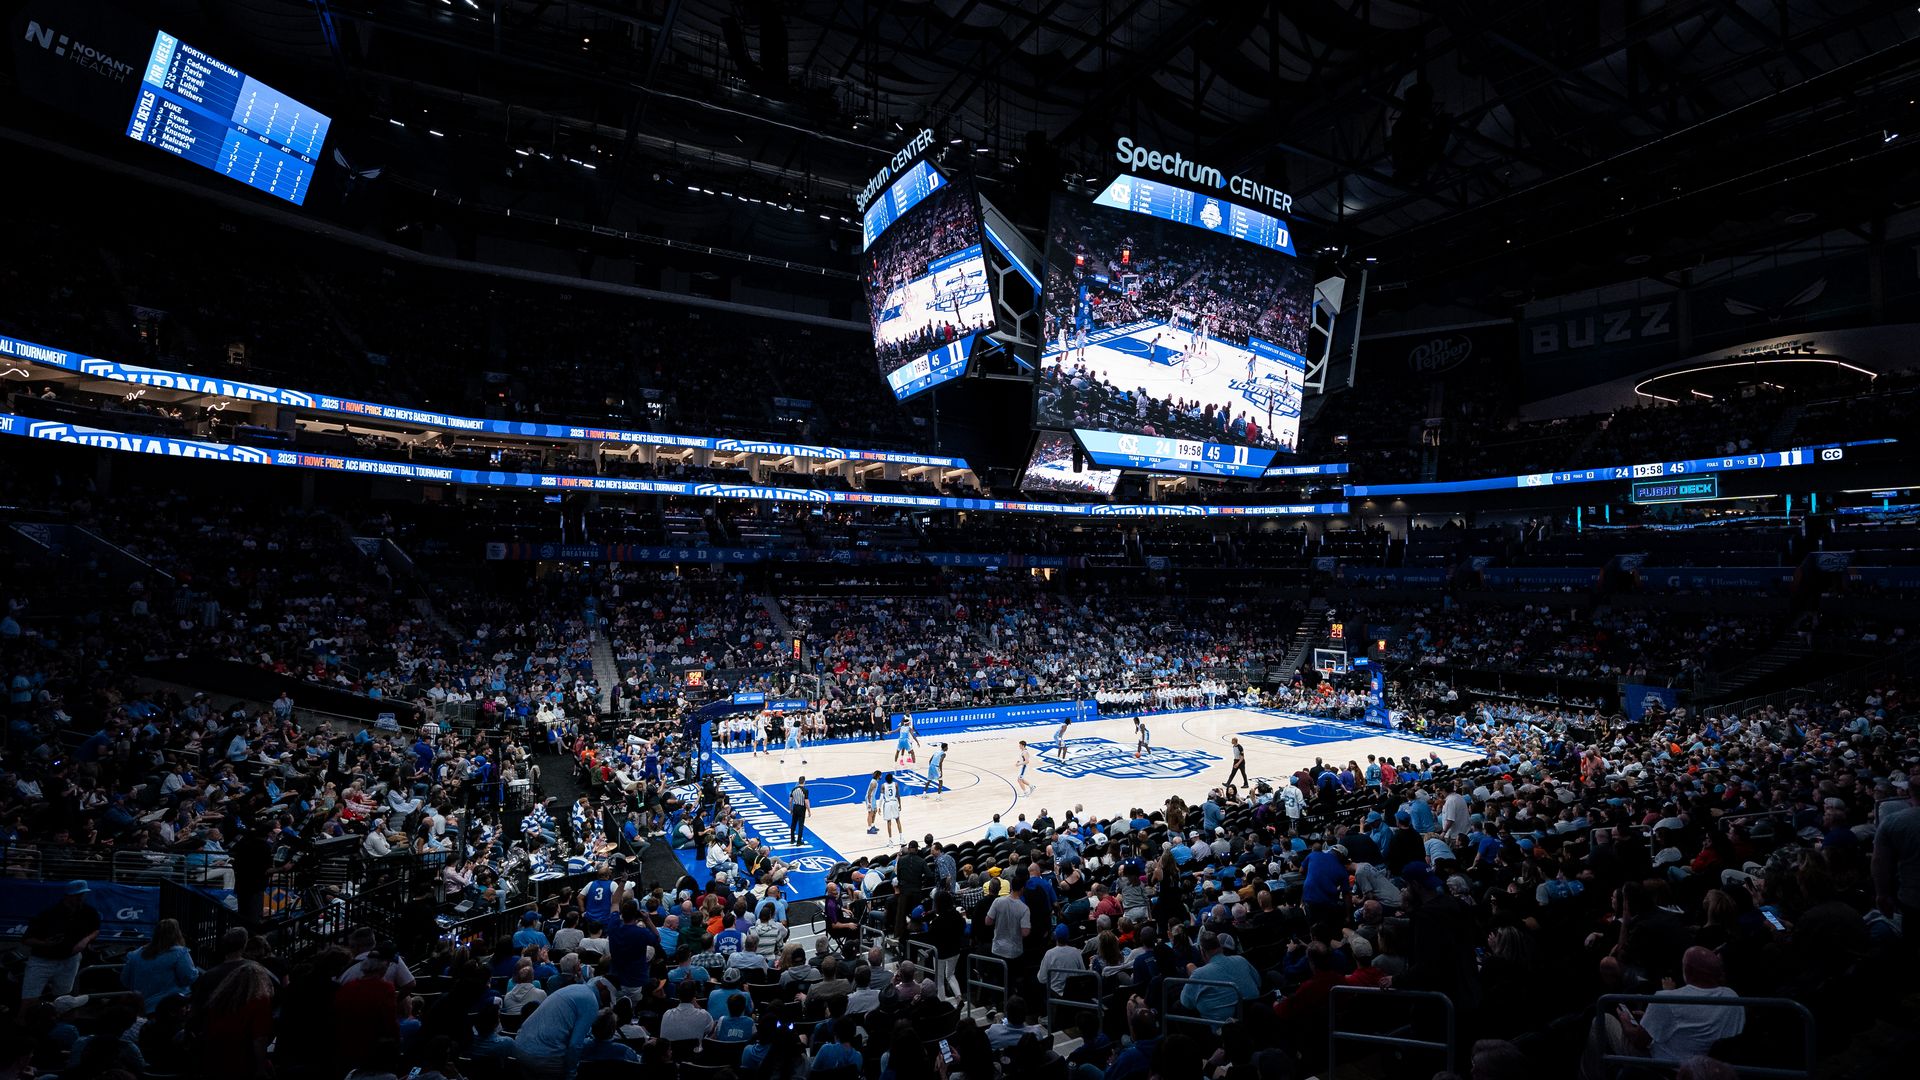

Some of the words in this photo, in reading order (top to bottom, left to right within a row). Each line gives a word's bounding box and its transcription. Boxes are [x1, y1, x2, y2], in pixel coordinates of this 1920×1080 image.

[154, 34, 173, 63] HEELS
[70, 51, 125, 83] HEALTH
[72, 41, 134, 76] NOVANT
[182, 44, 206, 61] NORTH
[206, 55, 239, 78] CAROLINA
[186, 58, 212, 75] Cadeau
[148, 63, 165, 84] TAR
[181, 72, 205, 87] Powell
[184, 65, 203, 79] Davis
[164, 80, 174, 90] 24
[177, 86, 203, 103] Withers
[167, 73, 177, 82] 22
[179, 78, 199, 93] Lubin
[136, 90, 155, 121] DEVILS
[163, 100, 183, 114] DUKE
[166, 119, 192, 134] Proctor
[168, 112, 189, 125] Evans
[130, 120, 147, 141] BLUE
[164, 126, 196, 144] Knueppel
[147, 135, 157, 144] 14
[160, 141, 182, 155] James
[856, 166, 890, 213] Spectrum
[891, 128, 934, 173] CENTER
[1116, 137, 1221, 189] Spectrum
[1230, 175, 1292, 214] CENTER
[1529, 301, 1671, 355] BUZZ
[16, 342, 67, 366] TOURNAMENT
[1430, 338, 1452, 356] Dr
[914, 360, 928, 372] 19:58
[932, 354, 940, 367] 45
[1415, 342, 1468, 372] Pepper
[322, 398, 339, 409] 2025
[346, 402, 364, 413] ROWE
[365, 404, 382, 416] PRICE
[383, 407, 395, 418] ACC
[396, 408, 413, 420] MEN'S
[413, 411, 447, 426] BASKETBALL
[447, 416, 484, 430] TOURNAMENT
[570, 428, 584, 438] 2025
[590, 430, 605, 439] ROWE
[606, 432, 620, 440] PRICE
[631, 434, 646, 442] MEN'S
[647, 434, 676, 445] BASKETBALL
[677, 437, 708, 447] TOURNAMENT
[906, 455, 929, 465] BASKETBALL
[929, 457, 952, 466] TOURNAMENT
[1178, 444, 1202, 456] 19:58
[1207, 446, 1220, 460] 45
[1823, 450, 1842, 459] CC
[278, 453, 296, 465] 2025
[298, 454, 303, 465] T.
[304, 455, 324, 467] ROWE
[325, 456, 344, 469] PRICE
[345, 459, 360, 471] ACC
[360, 460, 378, 472] MEN'S
[379, 461, 415, 476] BASKETBALL
[416, 466, 452, 480] TOURNAMENT
[1616, 468, 1629, 478] 24
[1634, 464, 1663, 476] 19:58
[1670, 463, 1685, 473] 45
[542, 476, 556, 485] 2025
[561, 478, 578, 487] ROWE
[578, 479, 594, 488] PRICE
[595, 480, 606, 489] ACC
[606, 481, 621, 490] MEN'S
[622, 481, 653, 491] BASKETBALL
[654, 483, 686, 492] TOURNAMENT
[1638, 485, 1678, 498] FLIGHT
[1679, 483, 1712, 496] DECK
[916, 714, 958, 725] ACCOMPLISH
[960, 712, 996, 721] GREATNESS
[888, 788, 893, 797] 3
[594, 887, 603, 900] 3
[727, 1028, 744, 1038] DAVIS
